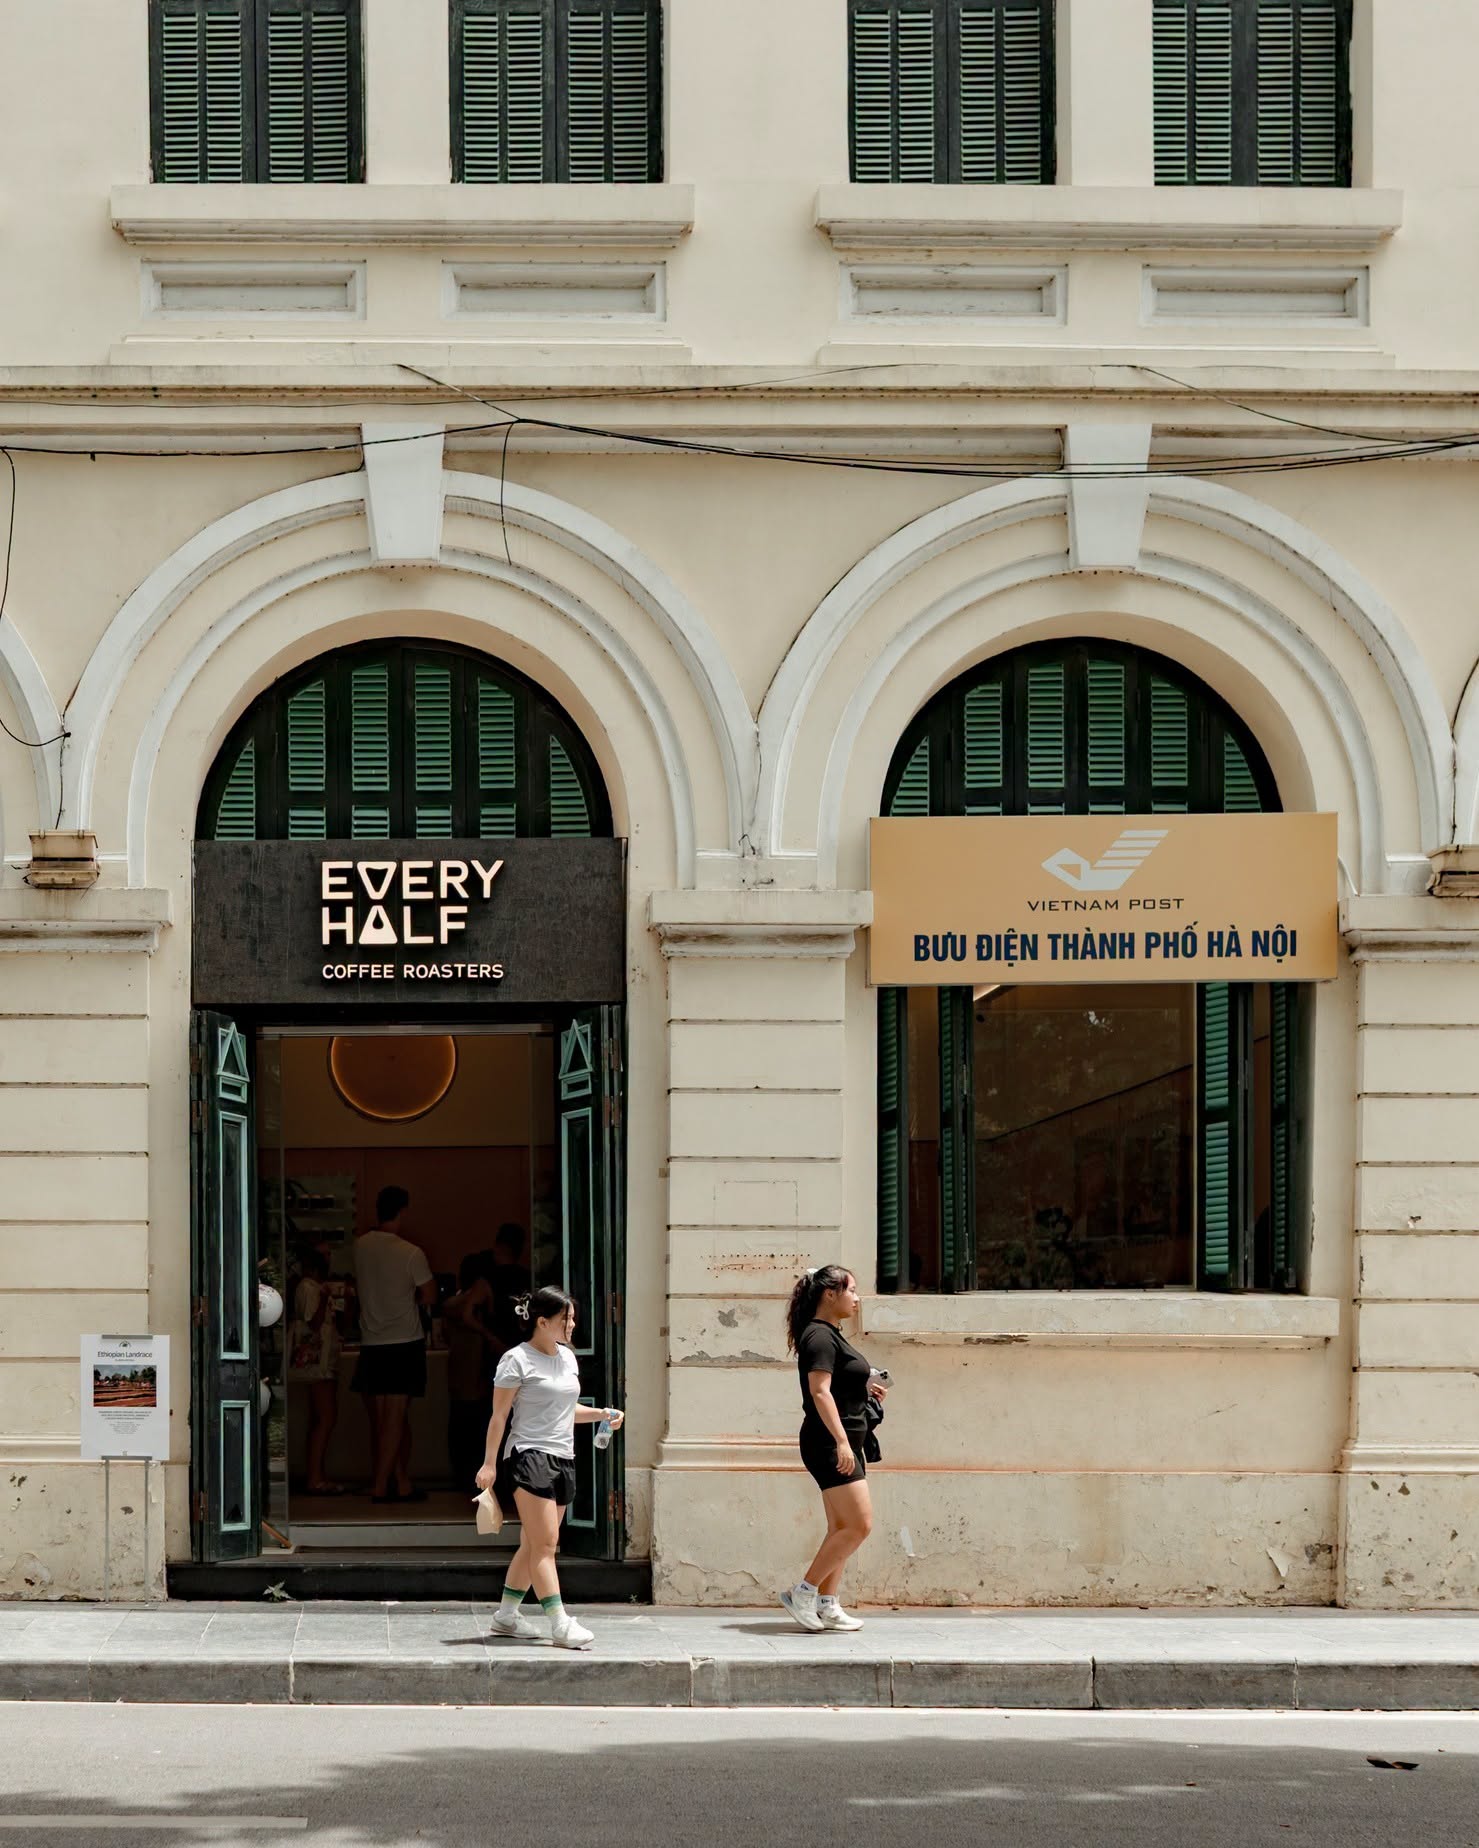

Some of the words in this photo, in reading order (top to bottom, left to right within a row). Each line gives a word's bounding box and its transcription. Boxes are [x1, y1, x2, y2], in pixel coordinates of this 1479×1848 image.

[321, 860, 504, 900] EVERY
[1027, 899, 1119, 912] VIETNAM
[1128, 898, 1185, 911] POST
[321, 905, 468, 945] HALF
[914, 931, 967, 962] BƯU
[975, 927, 1039, 968] ĐIỆN
[1047, 926, 1136, 961] THÀNH
[1144, 920, 1199, 959] PHỐ
[1207, 924, 1243, 958] HÀ
[1251, 923, 1297, 964] NỘI
[322, 964, 395, 979] COFFEE
[403, 963, 504, 979] ROASTERS
[97, 1350, 125, 1359] Ethiopian
